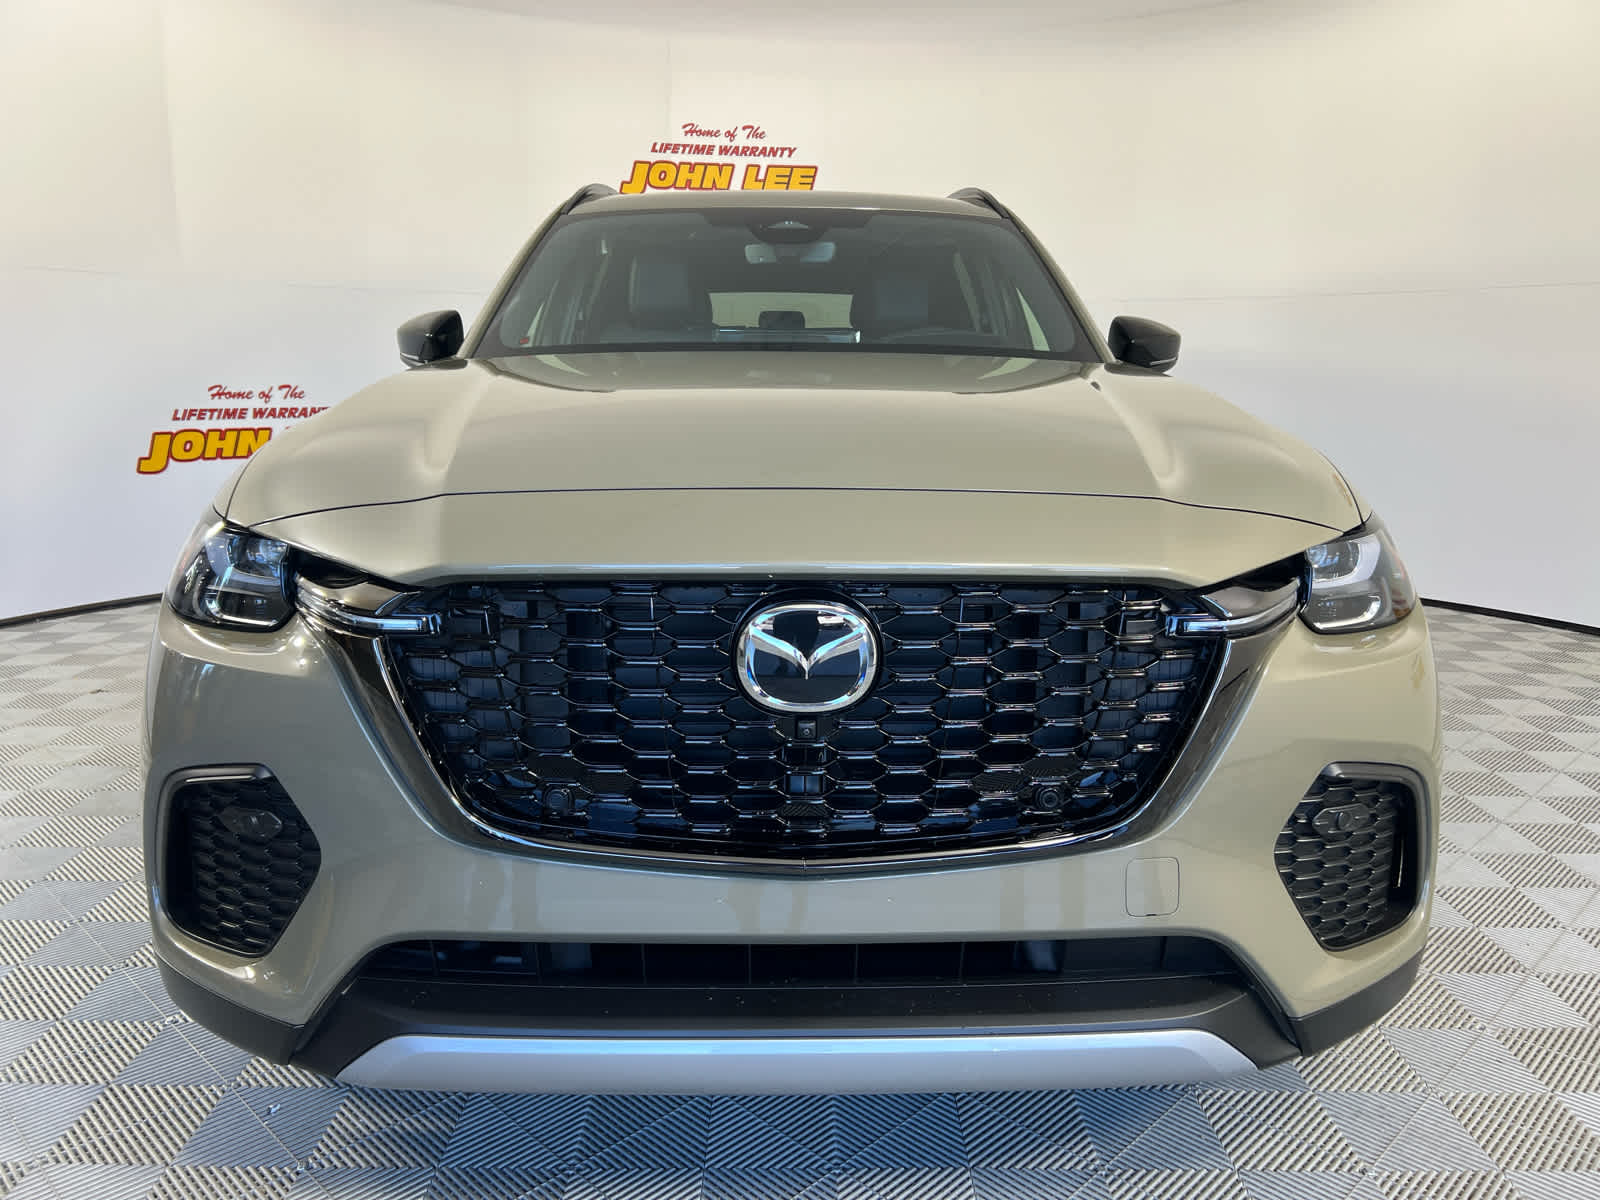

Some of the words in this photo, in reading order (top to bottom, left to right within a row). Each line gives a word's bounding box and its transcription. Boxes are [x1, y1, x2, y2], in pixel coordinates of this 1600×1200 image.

[682, 122, 721, 138] Home
[724, 127, 738, 141] of
[742, 124, 766, 139] The
[650, 142, 715, 156] LIFETIME
[718, 145, 797, 158] WARRANTY
[620, 160, 735, 194] JOHN
[741, 164, 818, 190] LEE
[207, 384, 254, 400] Home
[258, 387, 274, 403] of
[278, 384, 305, 400] The
[171, 408, 248, 421] LIFETIME
[252, 406, 330, 419] WARRAN
[136, 427, 272, 474] JOHN
